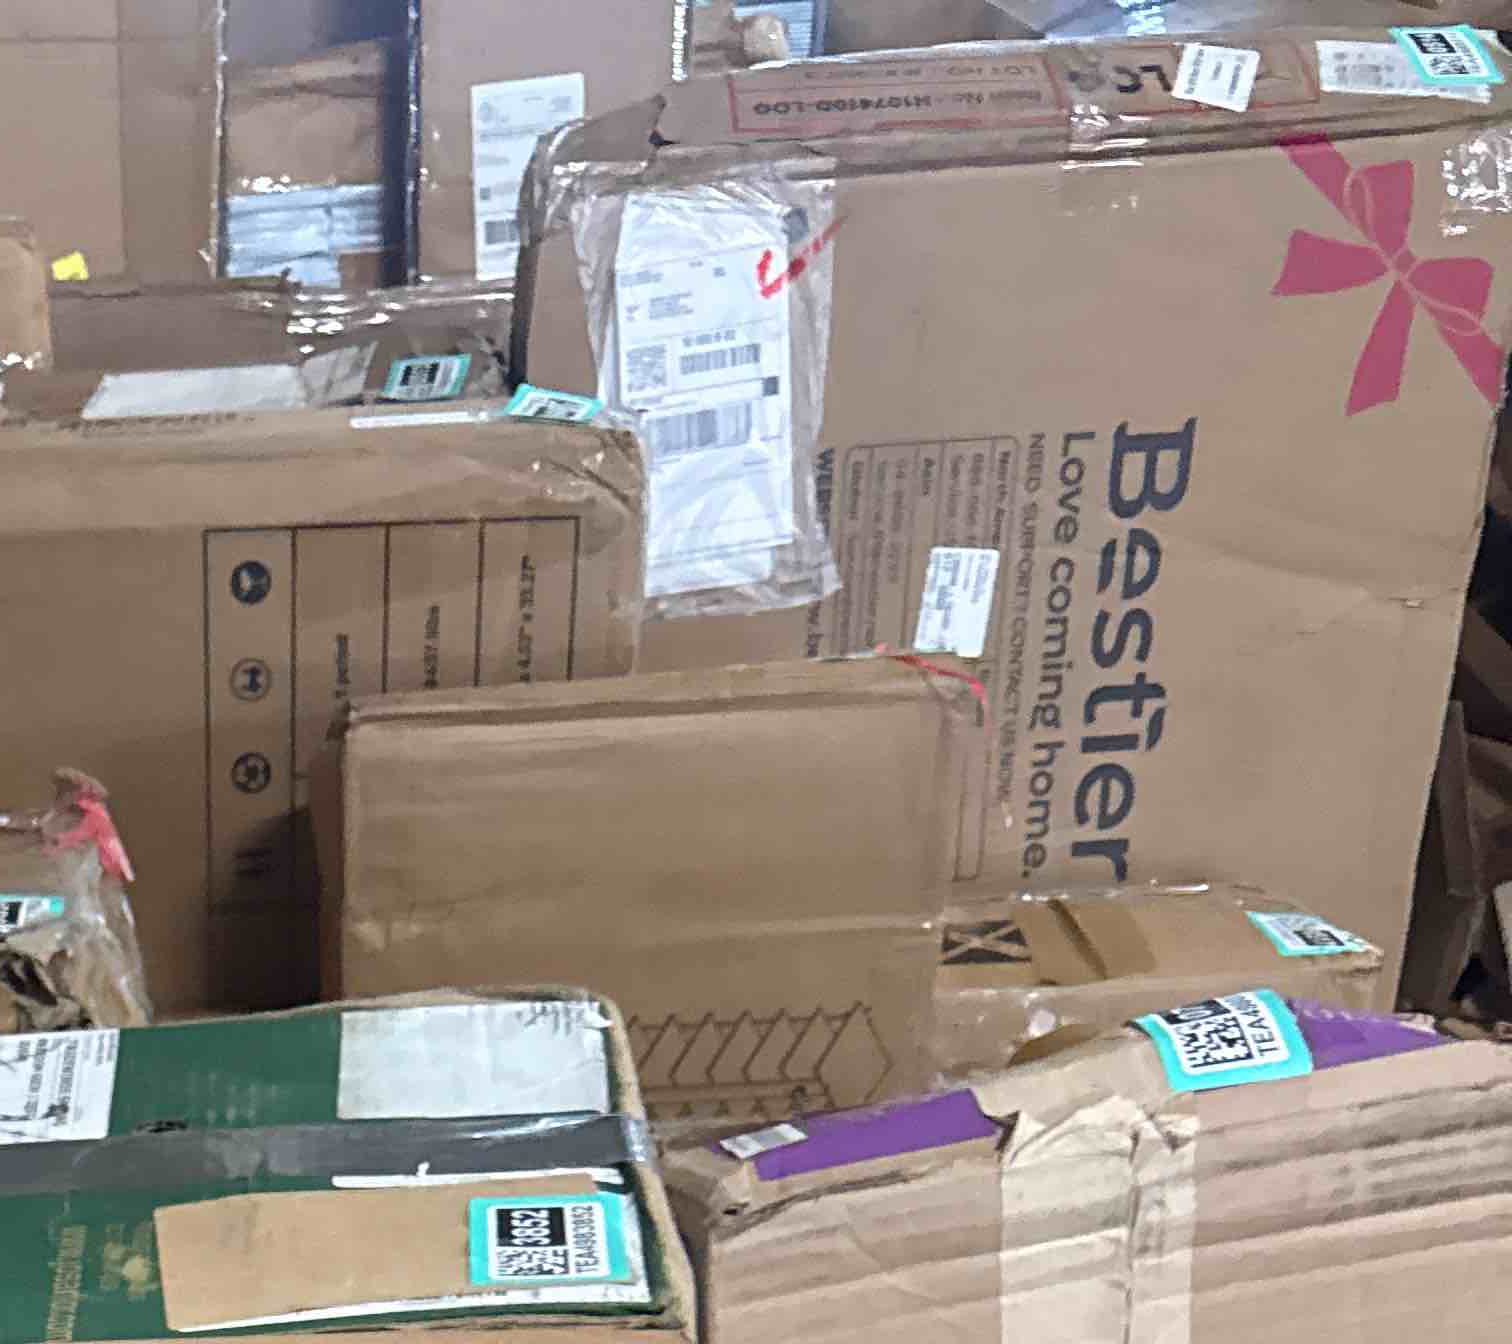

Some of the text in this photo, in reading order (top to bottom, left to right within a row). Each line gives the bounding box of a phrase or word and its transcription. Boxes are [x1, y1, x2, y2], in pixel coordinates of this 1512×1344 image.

[1022, 432, 1046, 493] NEED
[1002, 616, 1029, 717] CONTACT
[1021, 430, 1097, 880] Love coming home.
[1070, 415, 1199, 883] Bestier
[1000, 720, 1018, 748] US
[509, 1209, 552, 1246] 3852
[570, 1204, 601, 1274] TEA4983852
